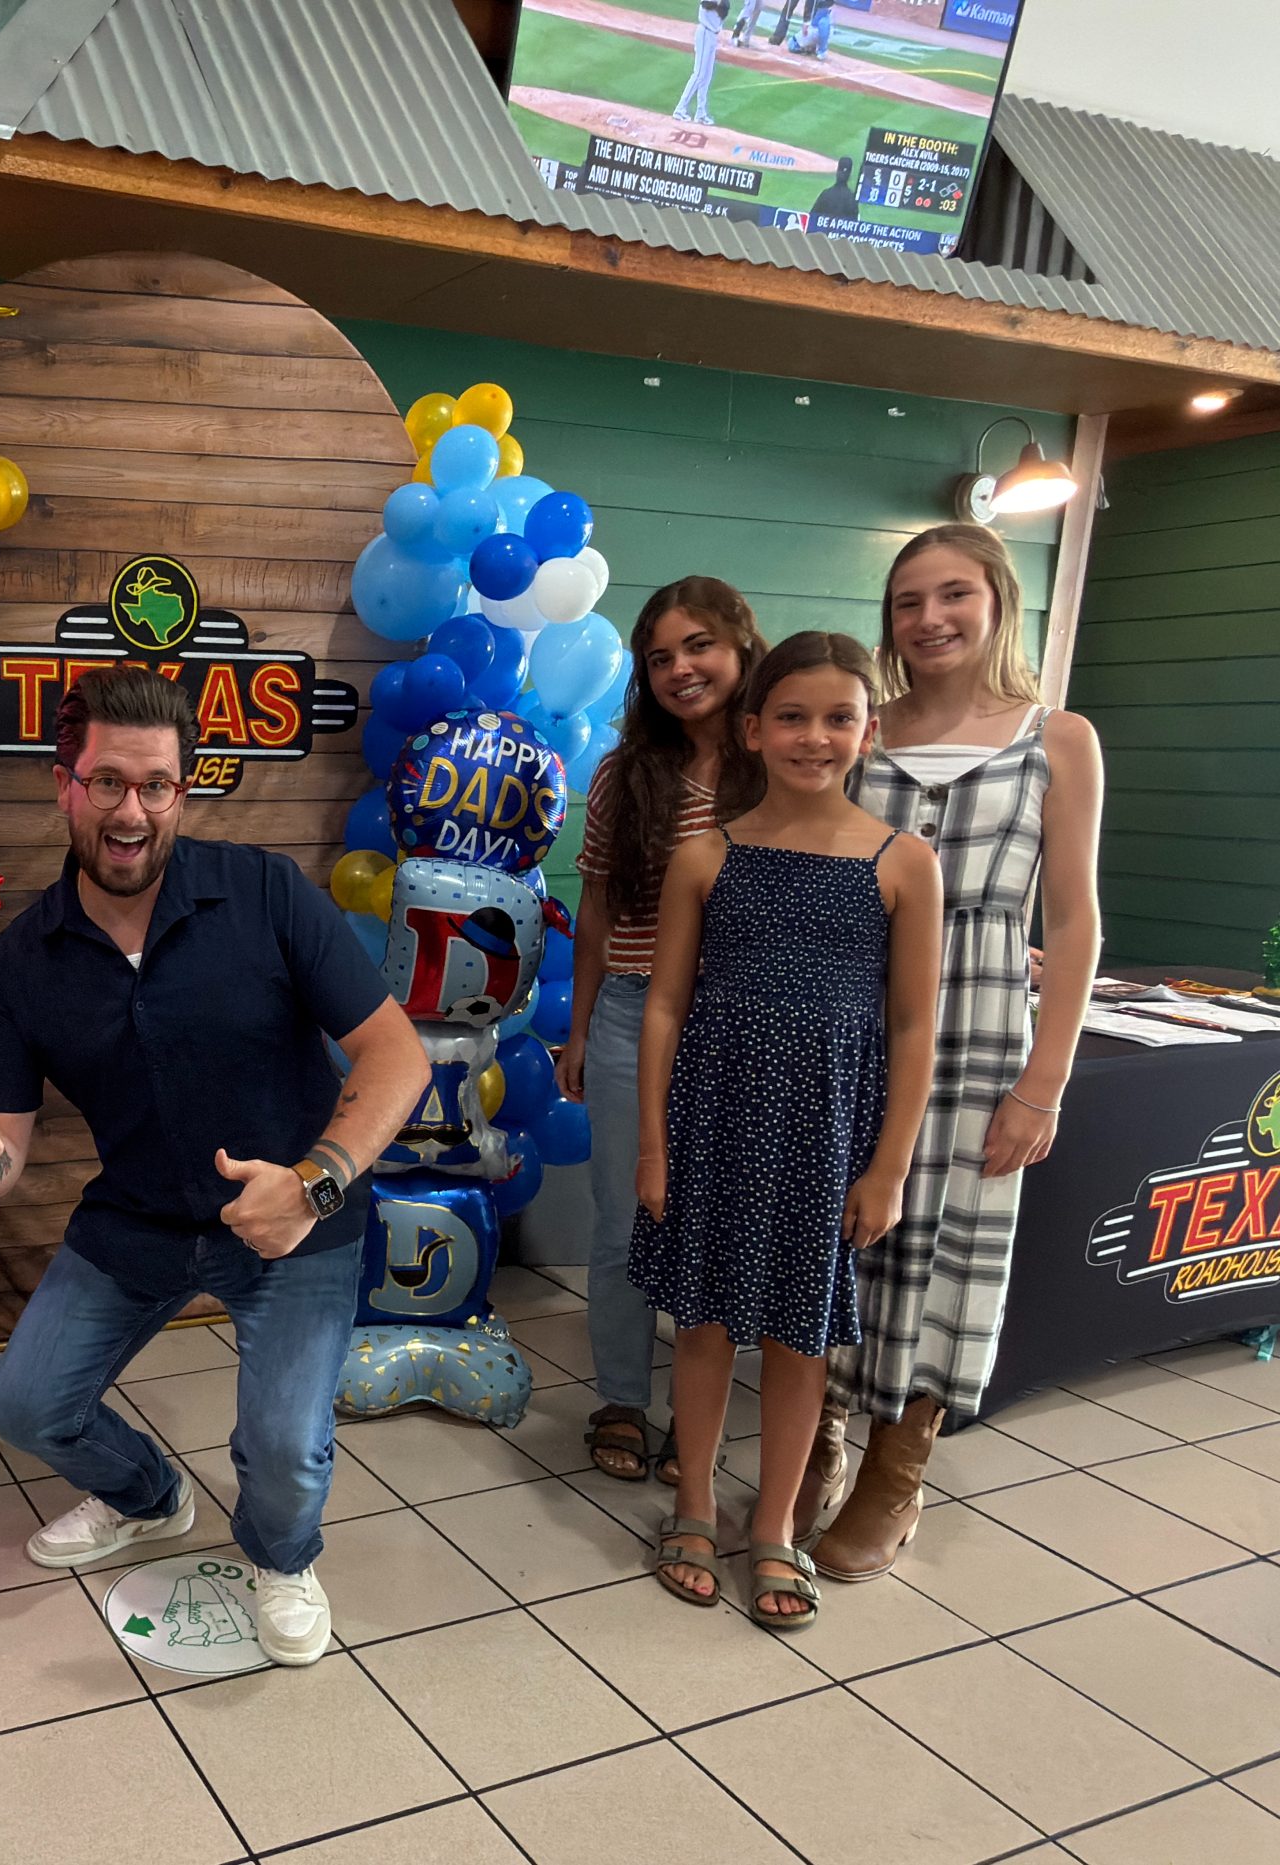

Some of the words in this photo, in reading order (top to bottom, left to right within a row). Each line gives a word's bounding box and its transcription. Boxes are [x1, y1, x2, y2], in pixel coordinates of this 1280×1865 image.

[595, 138, 614, 159] THE
[614, 143, 634, 164] DAY
[633, 148, 655, 169] FOR
[654, 153, 663, 171] A
[663, 155, 697, 178] WHITE
[697, 162, 718, 182] SOX
[718, 167, 755, 189] HITTER
[749, 150, 797, 167] McLaren
[865, 151, 890, 165] TIGERS
[889, 156, 920, 170] CATCHER
[883, 132, 896, 144] IN
[897, 134, 918, 148] THE
[918, 138, 959, 155] BOOTH:
[901, 147, 918, 158] ALEX
[919, 150, 939, 162] AVILA
[565, 170, 579, 181] TOP
[588, 164, 610, 185] AND
[610, 169, 622, 187] IN
[622, 171, 639, 191] MY
[638, 175, 703, 204] SCOREBOARD
[817, 216, 829, 227] BE
[829, 219, 836, 229] A
[836, 219, 859, 232] PART
[859, 223, 872, 234] OF
[872, 225, 888, 237] THE
[888, 228, 922, 241] ACTION
[0, 657, 302, 747] TAS
[449, 727, 552, 780] HAPPY
[418, 757, 557, 841] DAD'S
[435, 819, 515, 868] DAY!
[1148, 1165, 1280, 1263] TEX
[1170, 1249, 1280, 1293] ROADHOUS
